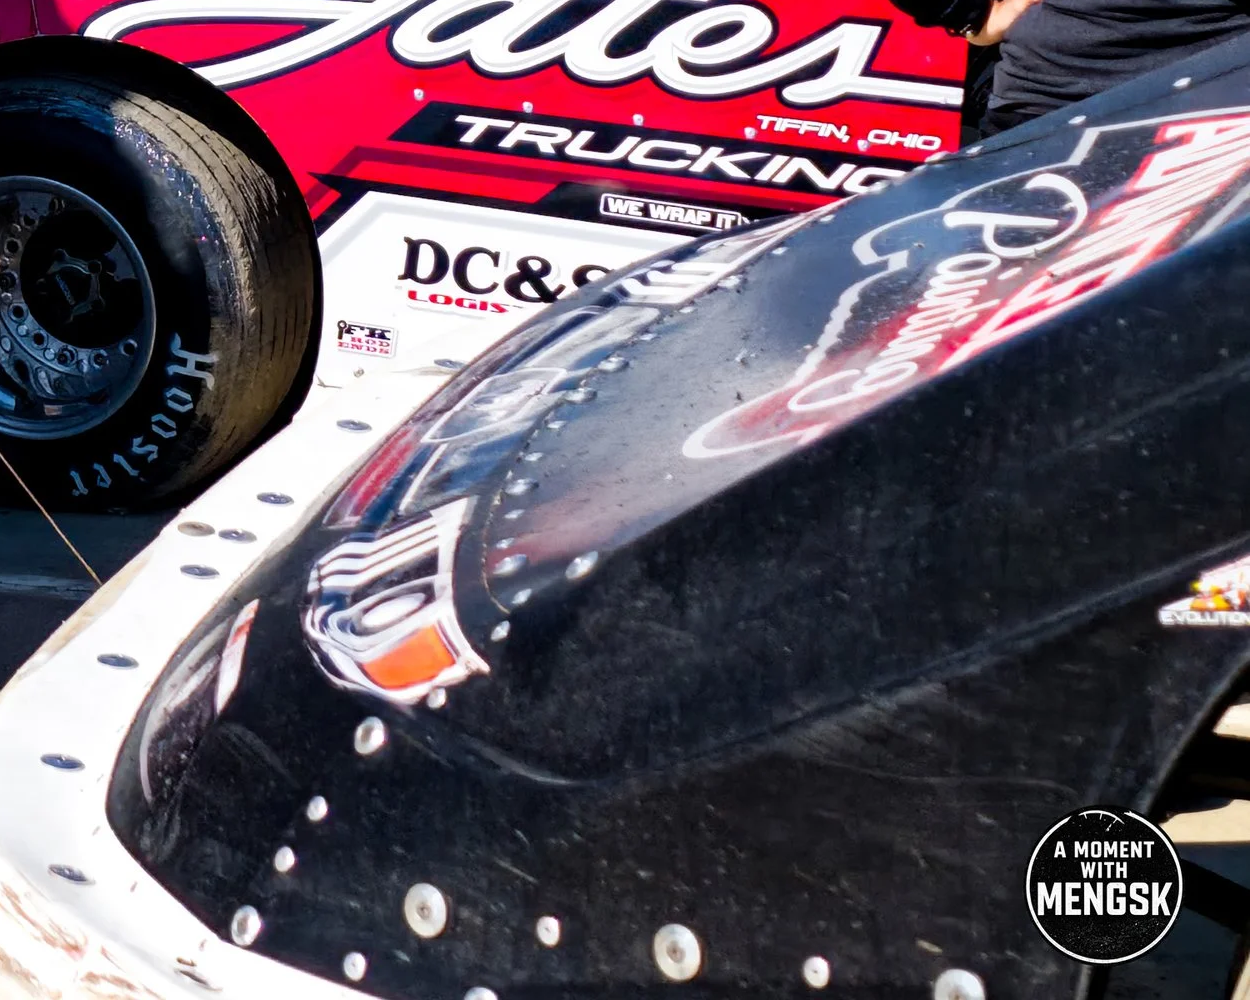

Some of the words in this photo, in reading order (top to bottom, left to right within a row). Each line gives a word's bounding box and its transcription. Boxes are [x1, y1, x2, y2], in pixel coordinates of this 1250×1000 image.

[756, 114, 851, 144] TIFFIN,
[867, 128, 942, 152] OHIO
[454, 113, 906, 195] TRUCKING
[607, 197, 645, 216] WE
[648, 203, 712, 226] WRAP
[715, 213, 737, 230] IT
[407, 289, 523, 314] LOGIS
[344, 323, 392, 341] FK
[350, 336, 391, 348] ROD
[337, 340, 391, 355] ENDS
[69, 332, 220, 496] Hoosier
